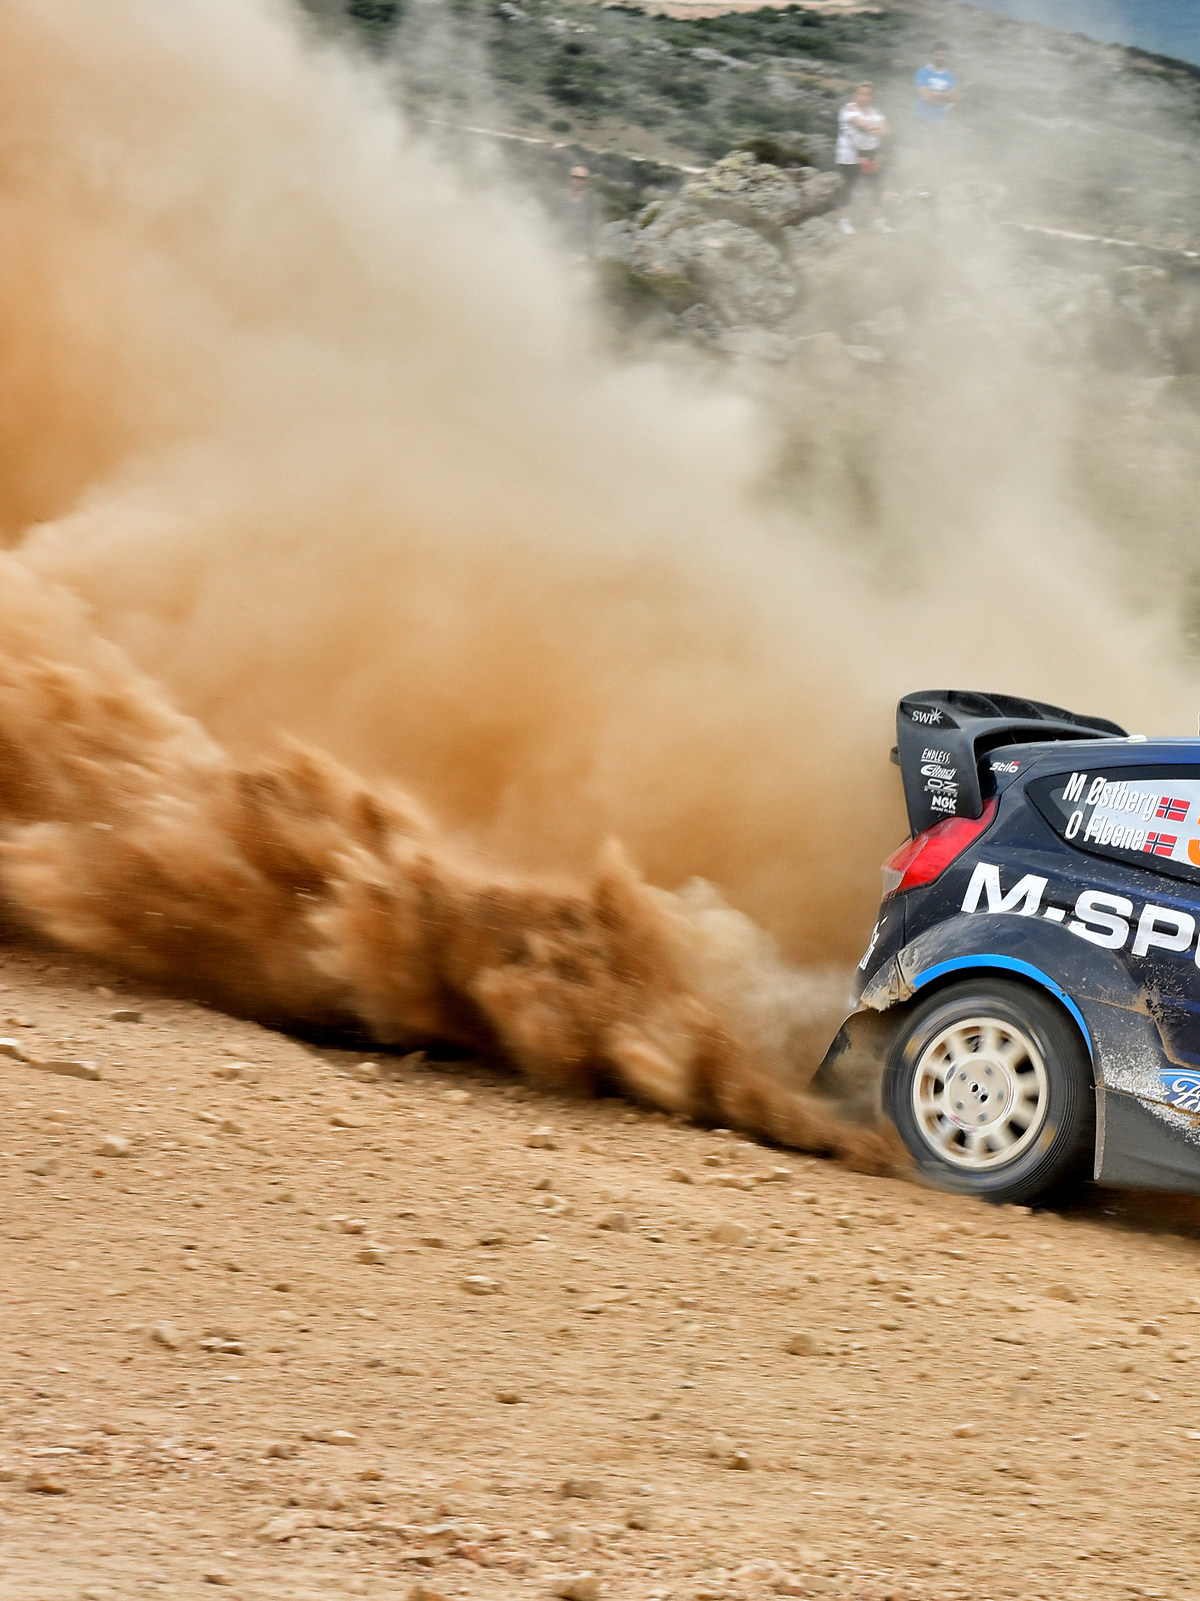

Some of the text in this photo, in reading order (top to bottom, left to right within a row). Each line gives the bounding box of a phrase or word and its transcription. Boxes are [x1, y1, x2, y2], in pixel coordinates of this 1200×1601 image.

[931, 795, 957, 810] NGK
[1062, 772, 1160, 822] M Østberg
[1064, 810, 1083, 840] O
